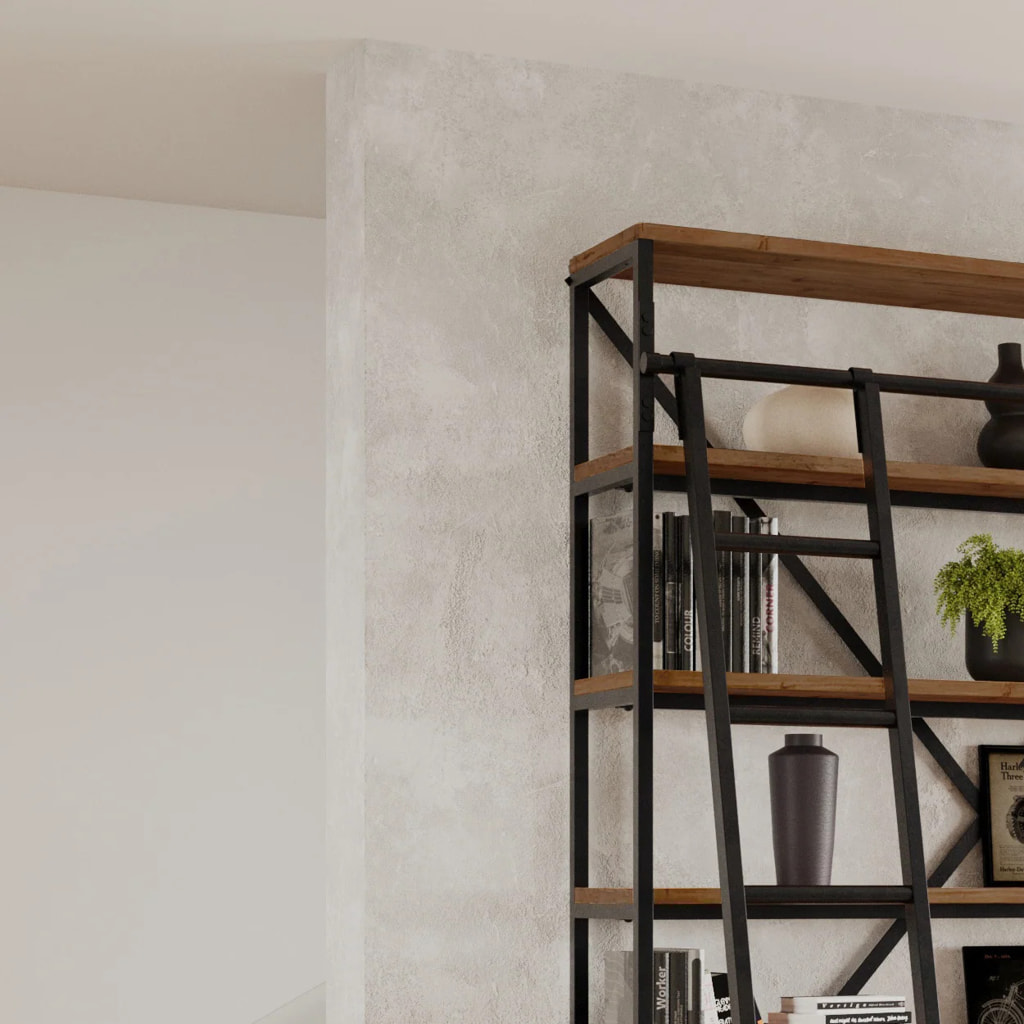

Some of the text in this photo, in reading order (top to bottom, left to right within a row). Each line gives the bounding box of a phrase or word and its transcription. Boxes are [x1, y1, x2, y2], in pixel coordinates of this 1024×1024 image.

[765, 583, 774, 633] CORNER
[684, 610, 693, 652] COLOUR
[752, 616, 761, 655] REMIND
[1001, 772, 1024, 780] Three
[656, 966, 667, 1010] Worker
